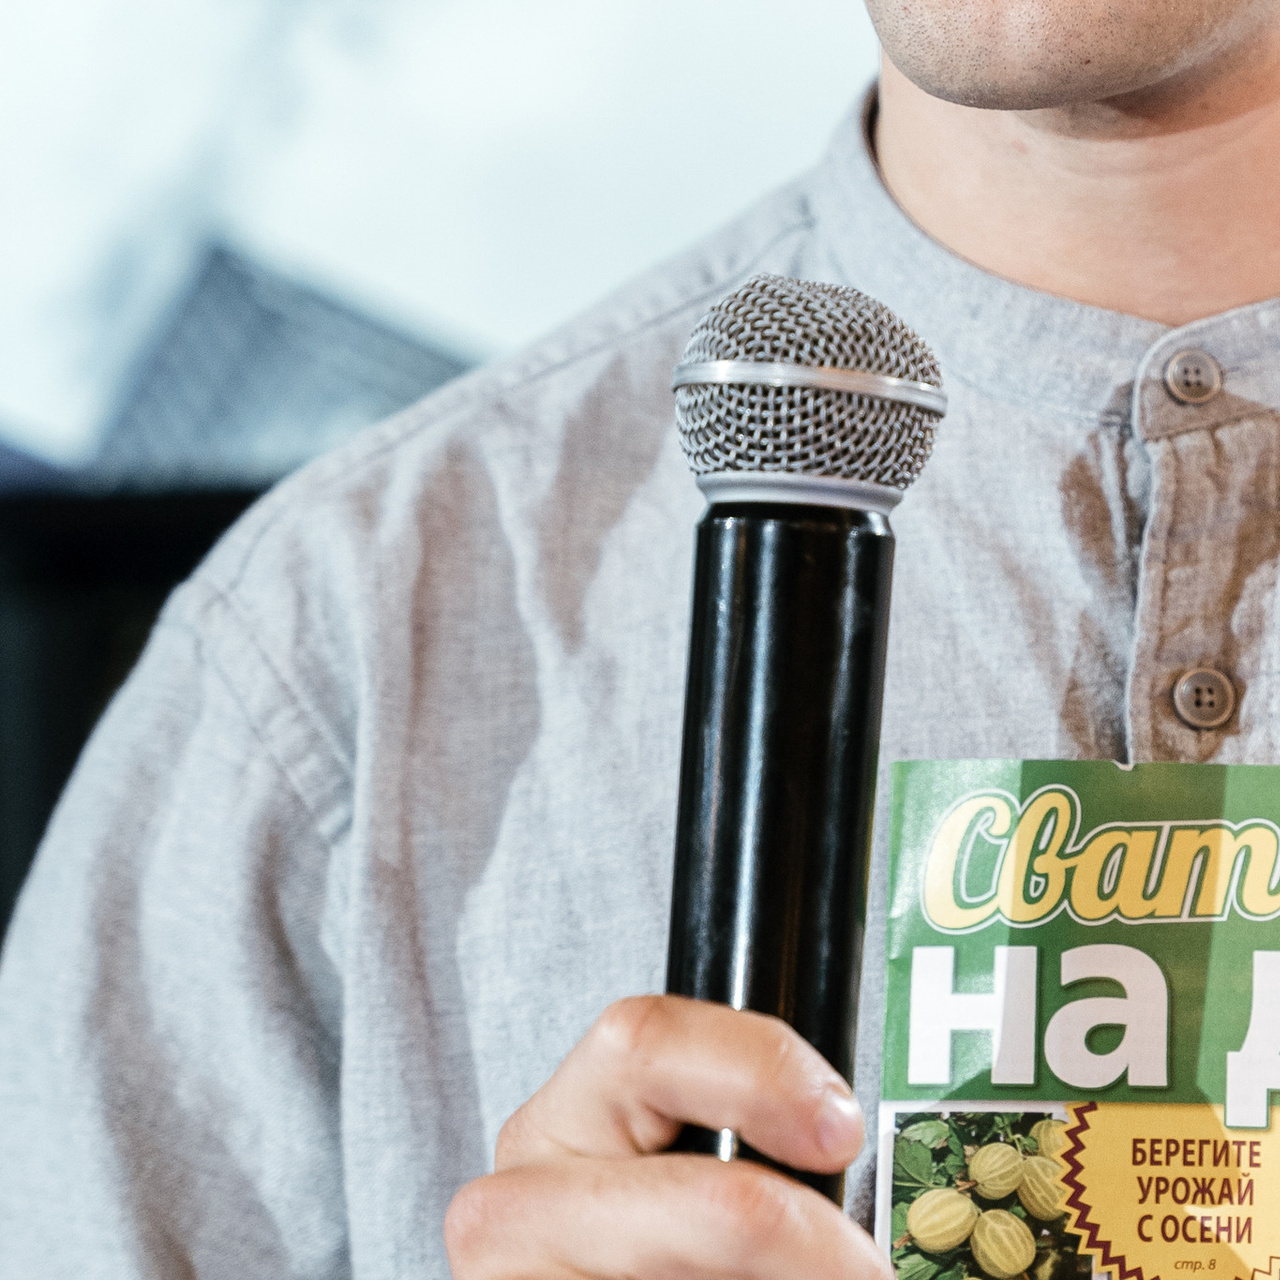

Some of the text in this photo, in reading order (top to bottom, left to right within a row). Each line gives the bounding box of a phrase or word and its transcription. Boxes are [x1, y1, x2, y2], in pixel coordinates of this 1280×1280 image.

[907, 943, 1168, 1088] на
[1132, 1138, 1262, 1169] БЕРЕГИТЕ
[1136, 1172, 1254, 1206] УРОЖАЙ
[1137, 1214, 1253, 1245] С ОСЕНИ
[1174, 1258, 1216, 1273] стр. 8
